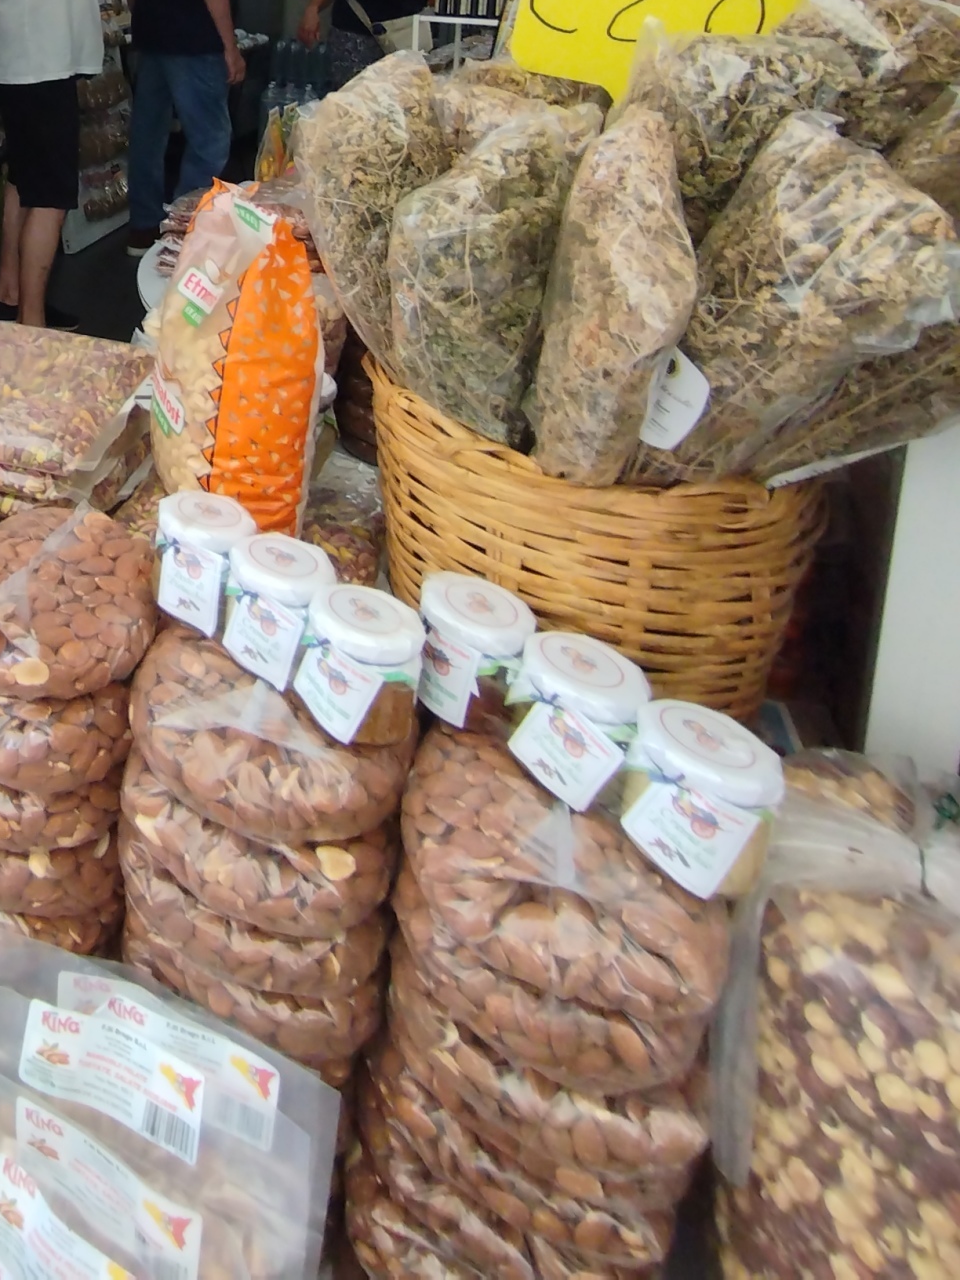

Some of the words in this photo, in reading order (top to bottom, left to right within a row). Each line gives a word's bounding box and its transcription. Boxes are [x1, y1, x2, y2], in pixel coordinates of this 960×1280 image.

[41, 1010, 81, 1034] KING
[107, 997, 146, 1026] KING
[25, 1107, 64, 1136] KING
[2, 1158, 37, 1198] KING
